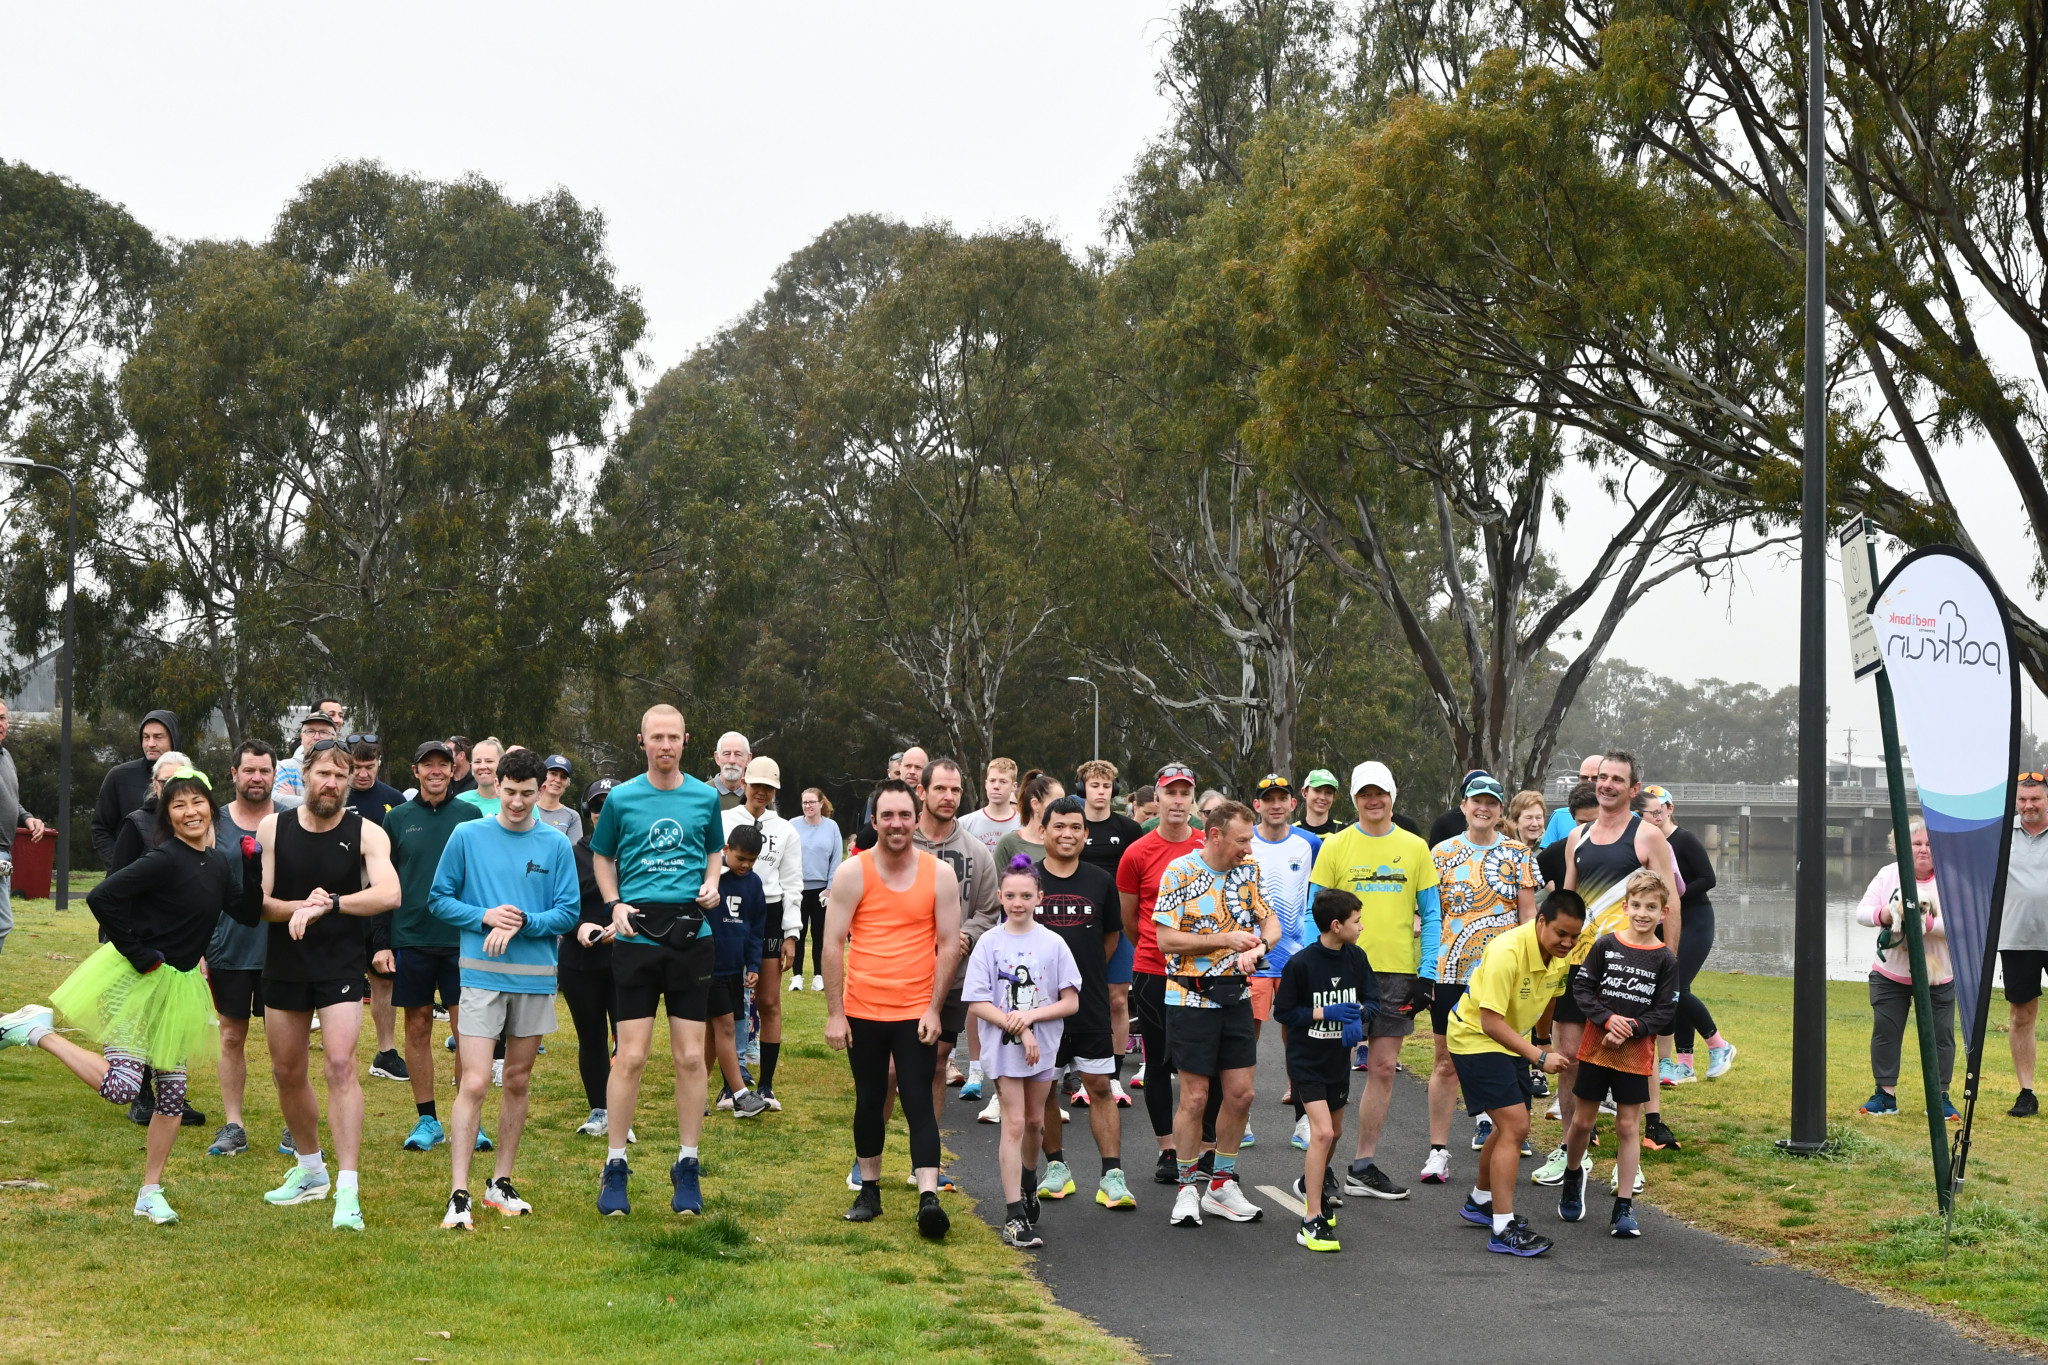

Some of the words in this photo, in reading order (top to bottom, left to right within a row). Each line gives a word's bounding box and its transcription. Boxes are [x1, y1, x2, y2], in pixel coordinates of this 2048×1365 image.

[600, 779, 612, 789] NY
[641, 858, 655, 867] Run
[1354, 881, 1403, 893] Adelaide
[1035, 905, 1093, 915] NIKE
[1608, 963, 1635, 974] 2024/25
[1636, 968, 1656, 980] STATE
[1601, 988, 1653, 1006] CHAMPIONSHIPS
